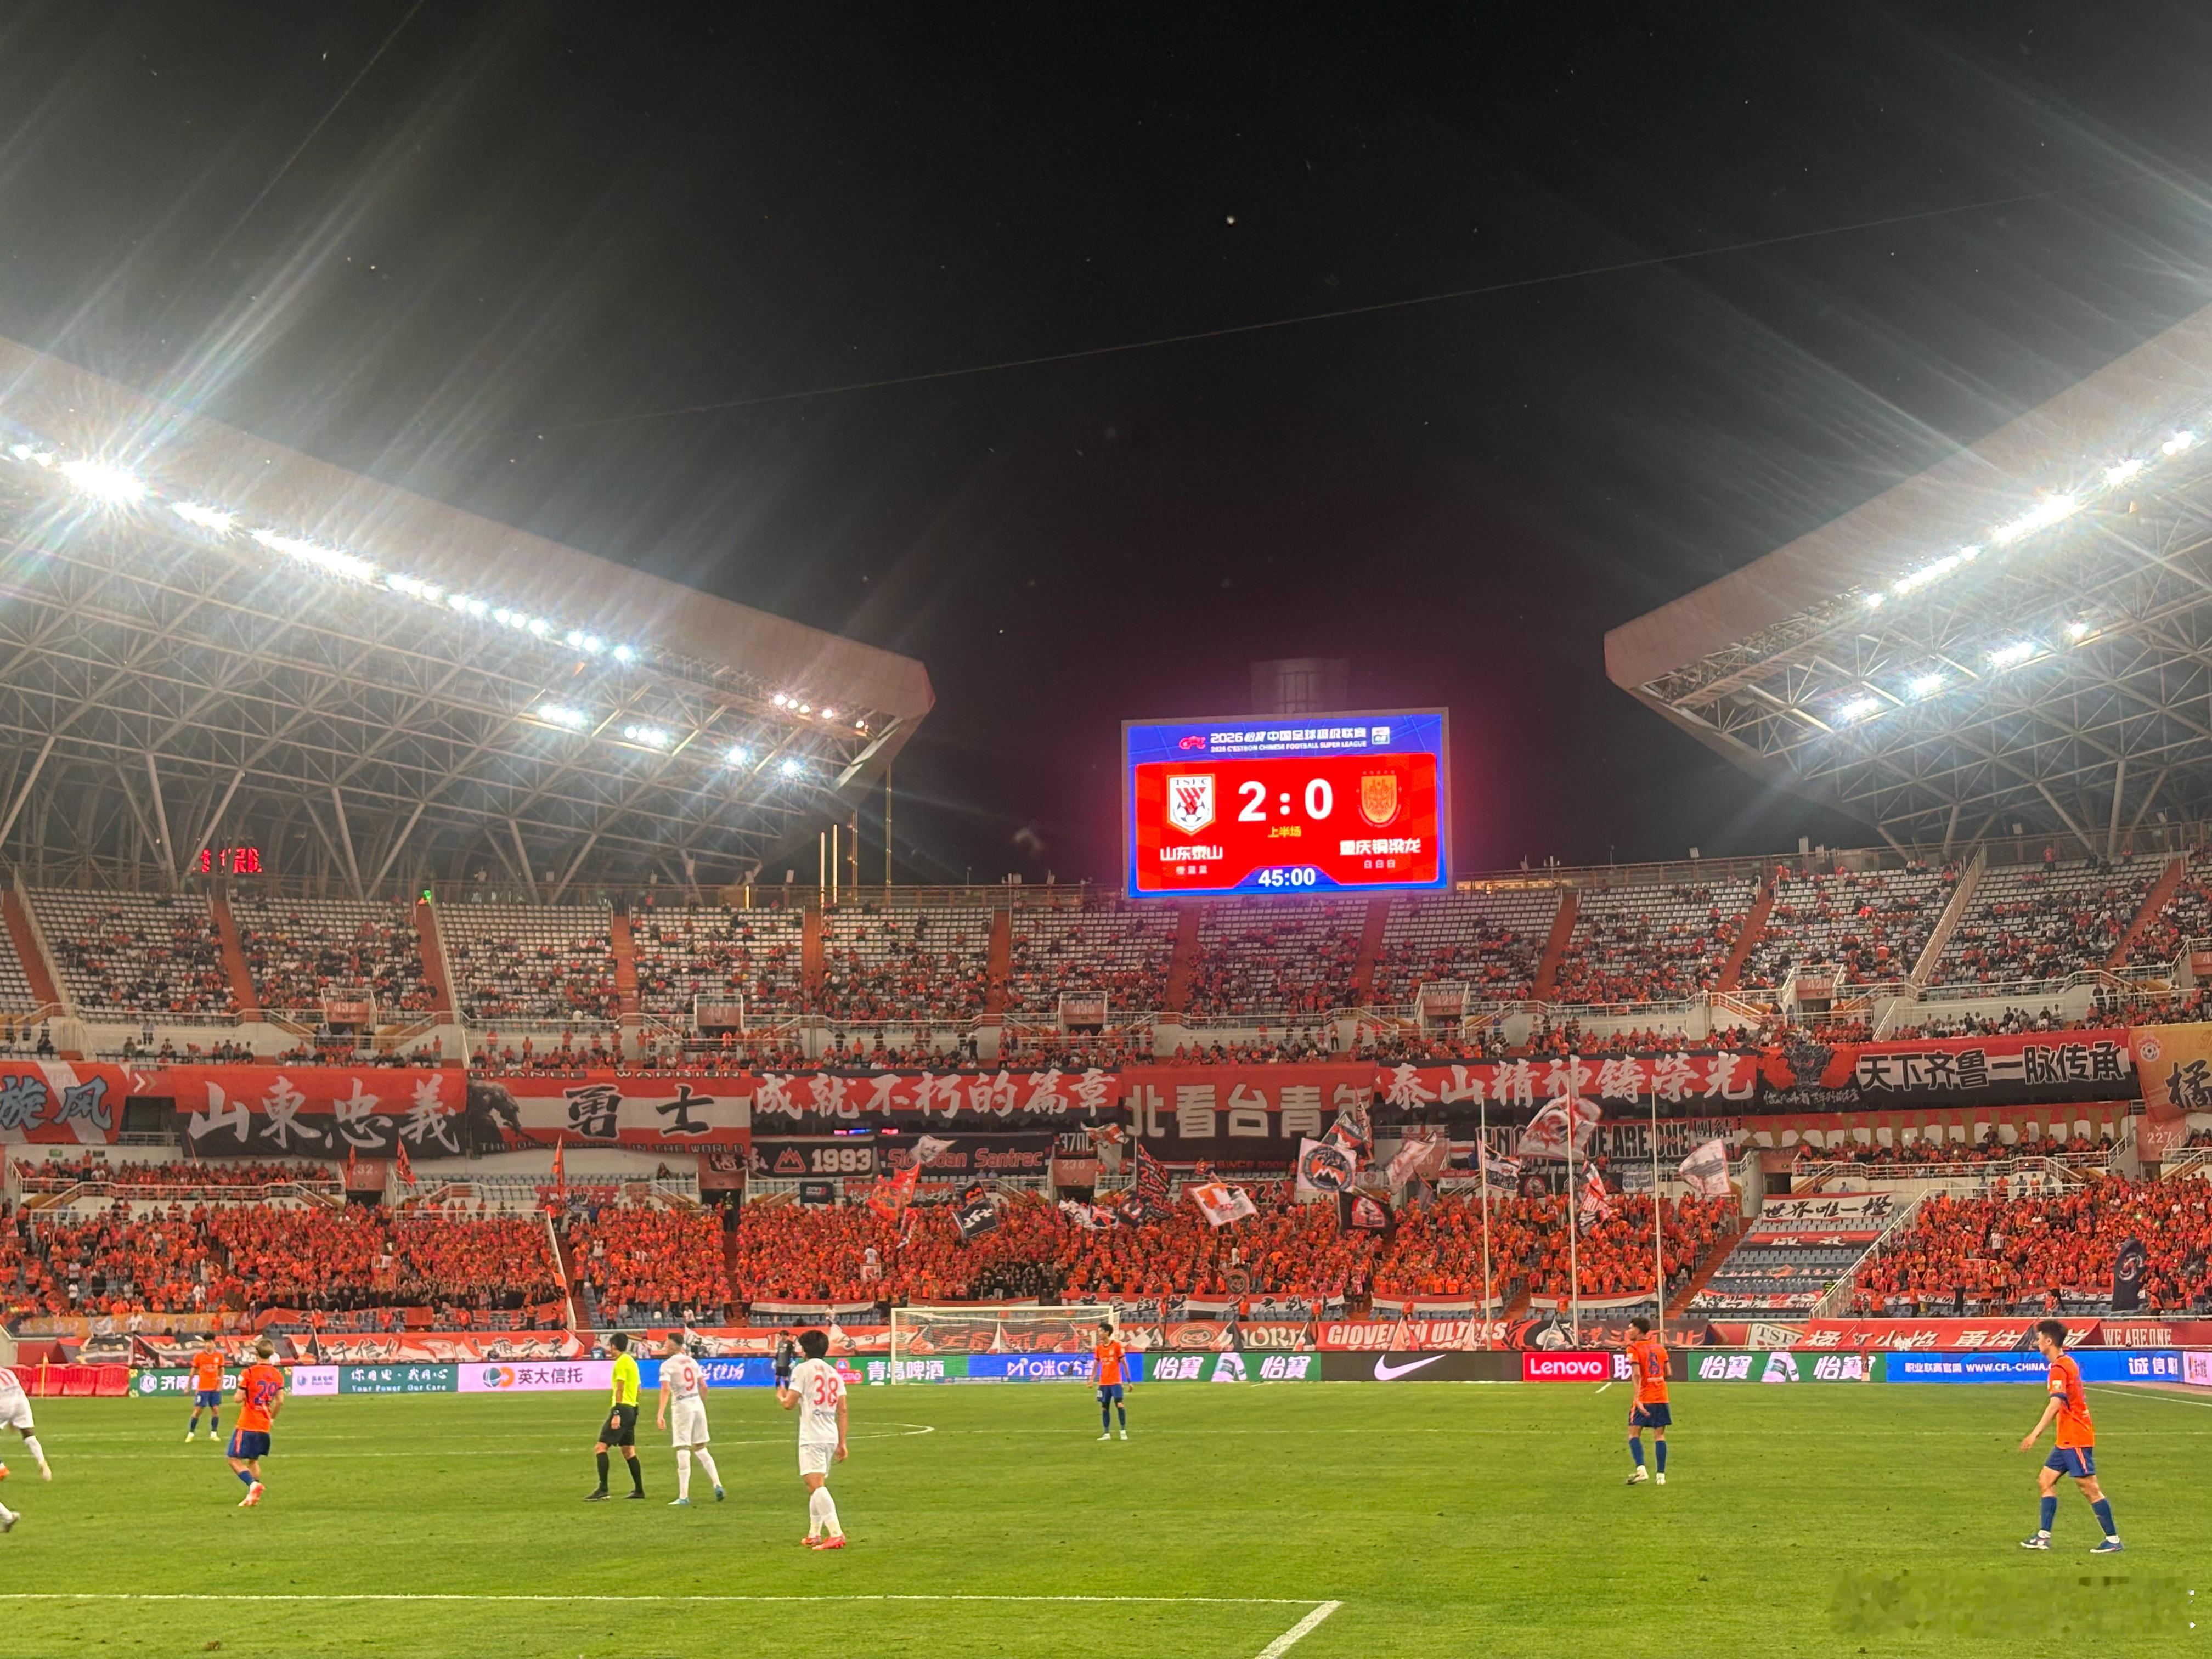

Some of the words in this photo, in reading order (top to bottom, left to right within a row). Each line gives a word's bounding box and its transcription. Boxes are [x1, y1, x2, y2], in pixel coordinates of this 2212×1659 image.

[1267, 825, 1302, 838] 上半场
[1160, 845, 1223, 861] 山东泰山
[1340, 838, 1421, 856] 重庆铜梁龙
[1258, 868, 1316, 887] 45:00
[1859, 1040, 2124, 1092] 天下齐鲁一脉传承
[755, 1068, 1116, 1120] 成就不朽的篇章
[189, 1073, 460, 1153] 山東忠義
[563, 1082, 715, 1140] 勇士
[691, 1143, 744, 1153] WORLD
[1612, 1123, 1649, 1159] ARE
[2147, 1131, 2172, 1144] 227
[811, 1149, 872, 1172] 1993
[887, 1148, 968, 1168] Slodan
[974, 1147, 1043, 1168] Santrac
[1062, 1160, 1086, 1170] 230
[2102, 1328, 2122, 1346] WE
[2125, 1328, 2147, 1346] ARE
[2148, 1328, 2173, 1346] ONE
[518, 1367, 583, 1384] 英大信托
[1260, 1356, 1311, 1379] 怡寶
[1530, 1358, 1602, 1375] Lenovo
[1699, 1356, 1753, 1380] 怡寶
[684, 1366, 695, 1391] 9
[813, 1375, 839, 1407] 38
